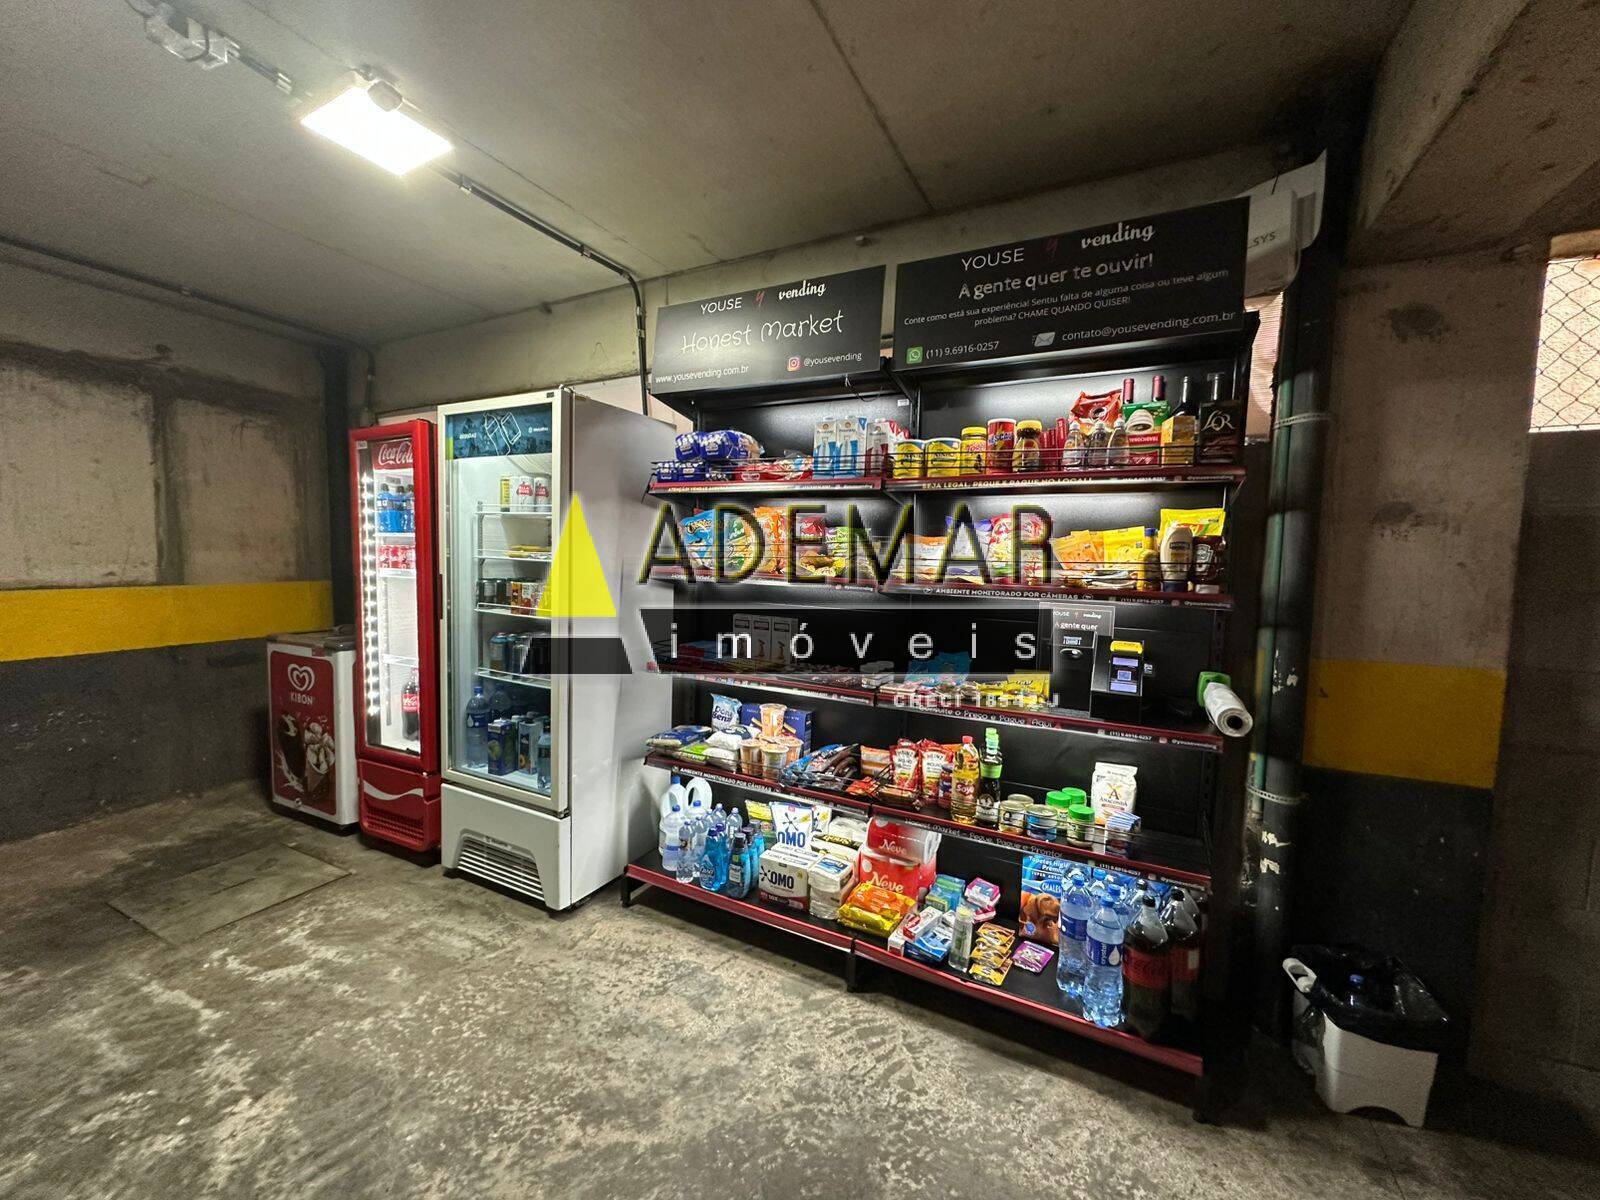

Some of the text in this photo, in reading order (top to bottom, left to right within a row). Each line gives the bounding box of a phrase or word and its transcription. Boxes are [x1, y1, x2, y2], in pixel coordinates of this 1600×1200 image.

[962, 248, 1024, 270] YOUSE
[1081, 222, 1156, 249] vending
[958, 252, 1154, 300] A gente quer te ouvir!
[701, 296, 742, 315] YOUSE
[778, 280, 826, 300] vending
[904, 316, 925, 326] Conte
[926, 314, 946, 322] como
[948, 310, 964, 318] está
[966, 308, 980, 316] sua
[1031, 295, 1058, 306] Sentiu
[1060, 292, 1080, 302] falta
[1082, 290, 1093, 299] de
[1094, 284, 1128, 298] alguma
[1131, 280, 1154, 291] coisa
[1157, 278, 1170, 287] ou
[1173, 274, 1194, 285] teve
[1197, 268, 1229, 282] algum
[974, 296, 1131, 327] problema? CHAME QUANDO QUISER!
[681, 309, 844, 354] Honest Market
[1062, 310, 1236, 342] contato@yousevending.com.br
[803, 352, 862, 367] @yousevending
[926, 348, 943, 360] (11)
[655, 364, 749, 384] www.yousevending.com.br
[936, 587, 970, 595] AMBIENTE
[971, 589, 1022, 598] MONITORADO
[1040, 591, 1078, 600] CÂMERAS
[777, 831, 806, 848] OMO
[880, 838, 908, 855] Neve
[770, 870, 794, 890] OMO
[869, 871, 904, 894] Neve
